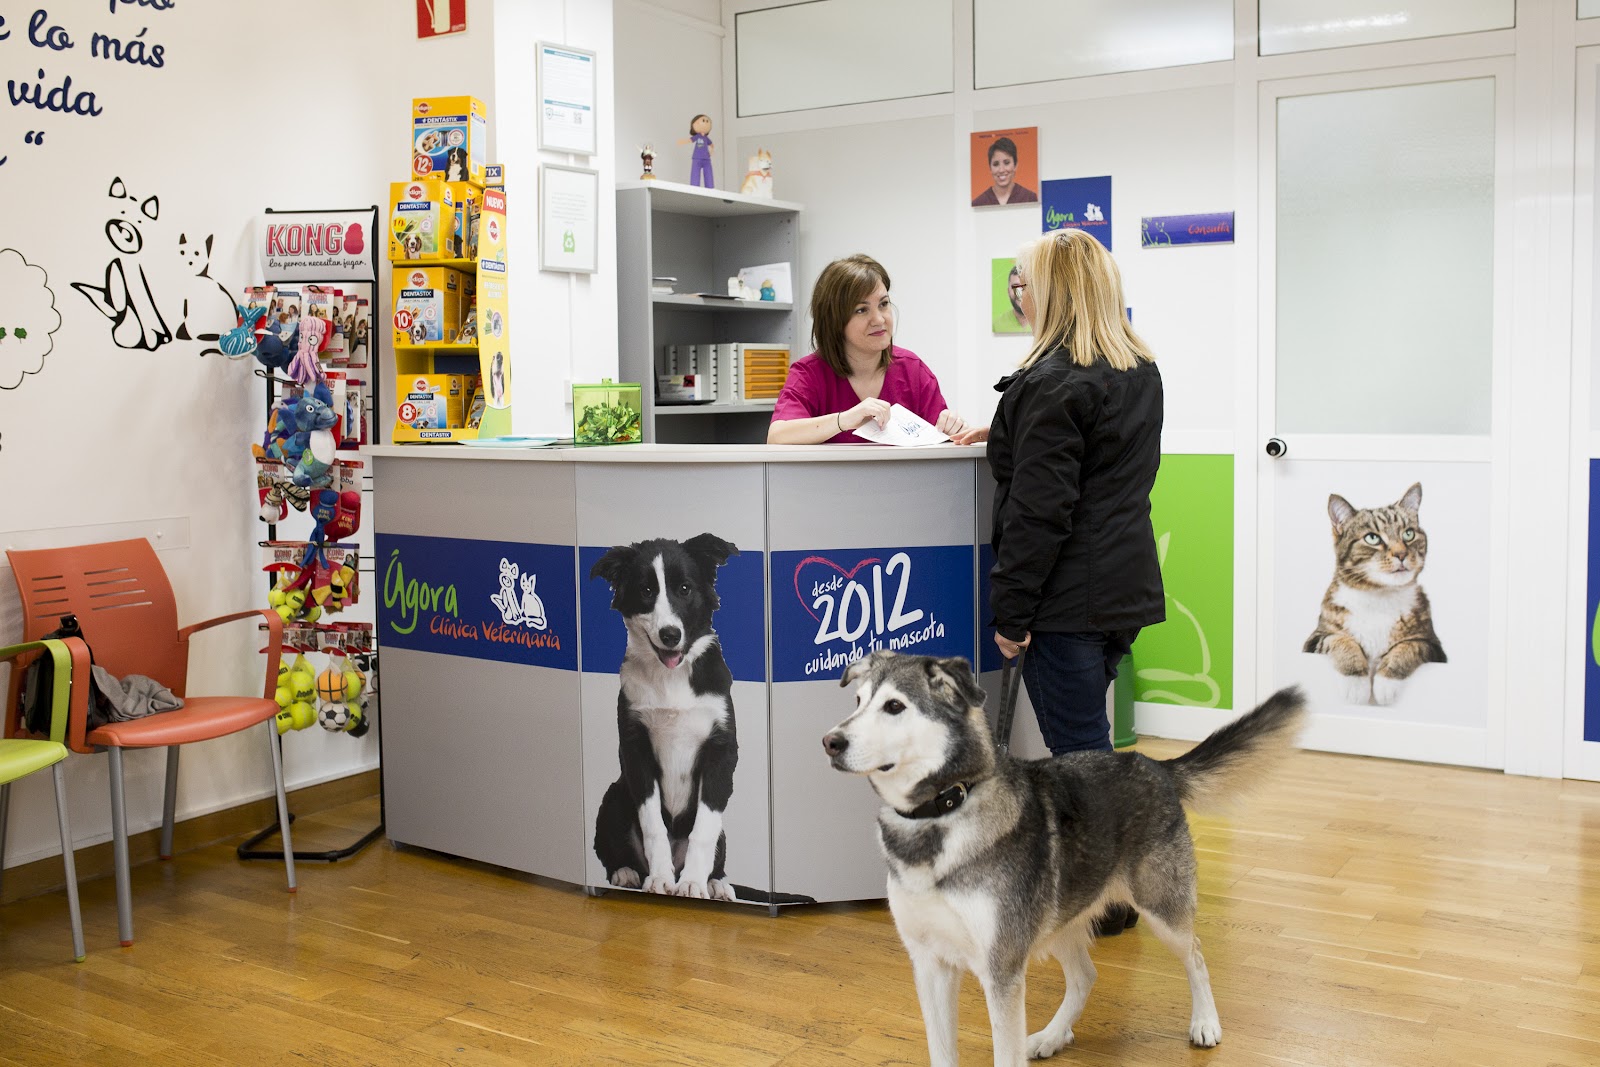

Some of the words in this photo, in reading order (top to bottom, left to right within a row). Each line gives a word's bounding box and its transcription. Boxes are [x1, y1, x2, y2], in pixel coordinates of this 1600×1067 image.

[28, 9, 74, 51] lo
[91, 27, 165, 68] más
[7, 68, 103, 117] vida
[486, 195, 504, 210] NUEVO
[1046, 205, 1075, 230] Ágora
[266, 223, 343, 257] KONG
[1187, 221, 1230, 235] Consulta
[283, 260, 307, 270] perros
[309, 257, 342, 267] necesitan
[343, 258, 367, 270] jugar.
[326, 549, 345, 557] KONG
[384, 549, 458, 635] Ágora
[812, 575, 844, 598] desde
[812, 552, 924, 645] 2012
[430, 615, 479, 641] Clínica
[482, 621, 561, 651] Veterinaria
[805, 642, 864, 675] cuidando
[868, 629, 883, 653] tu
[889, 612, 945, 651] mascota
